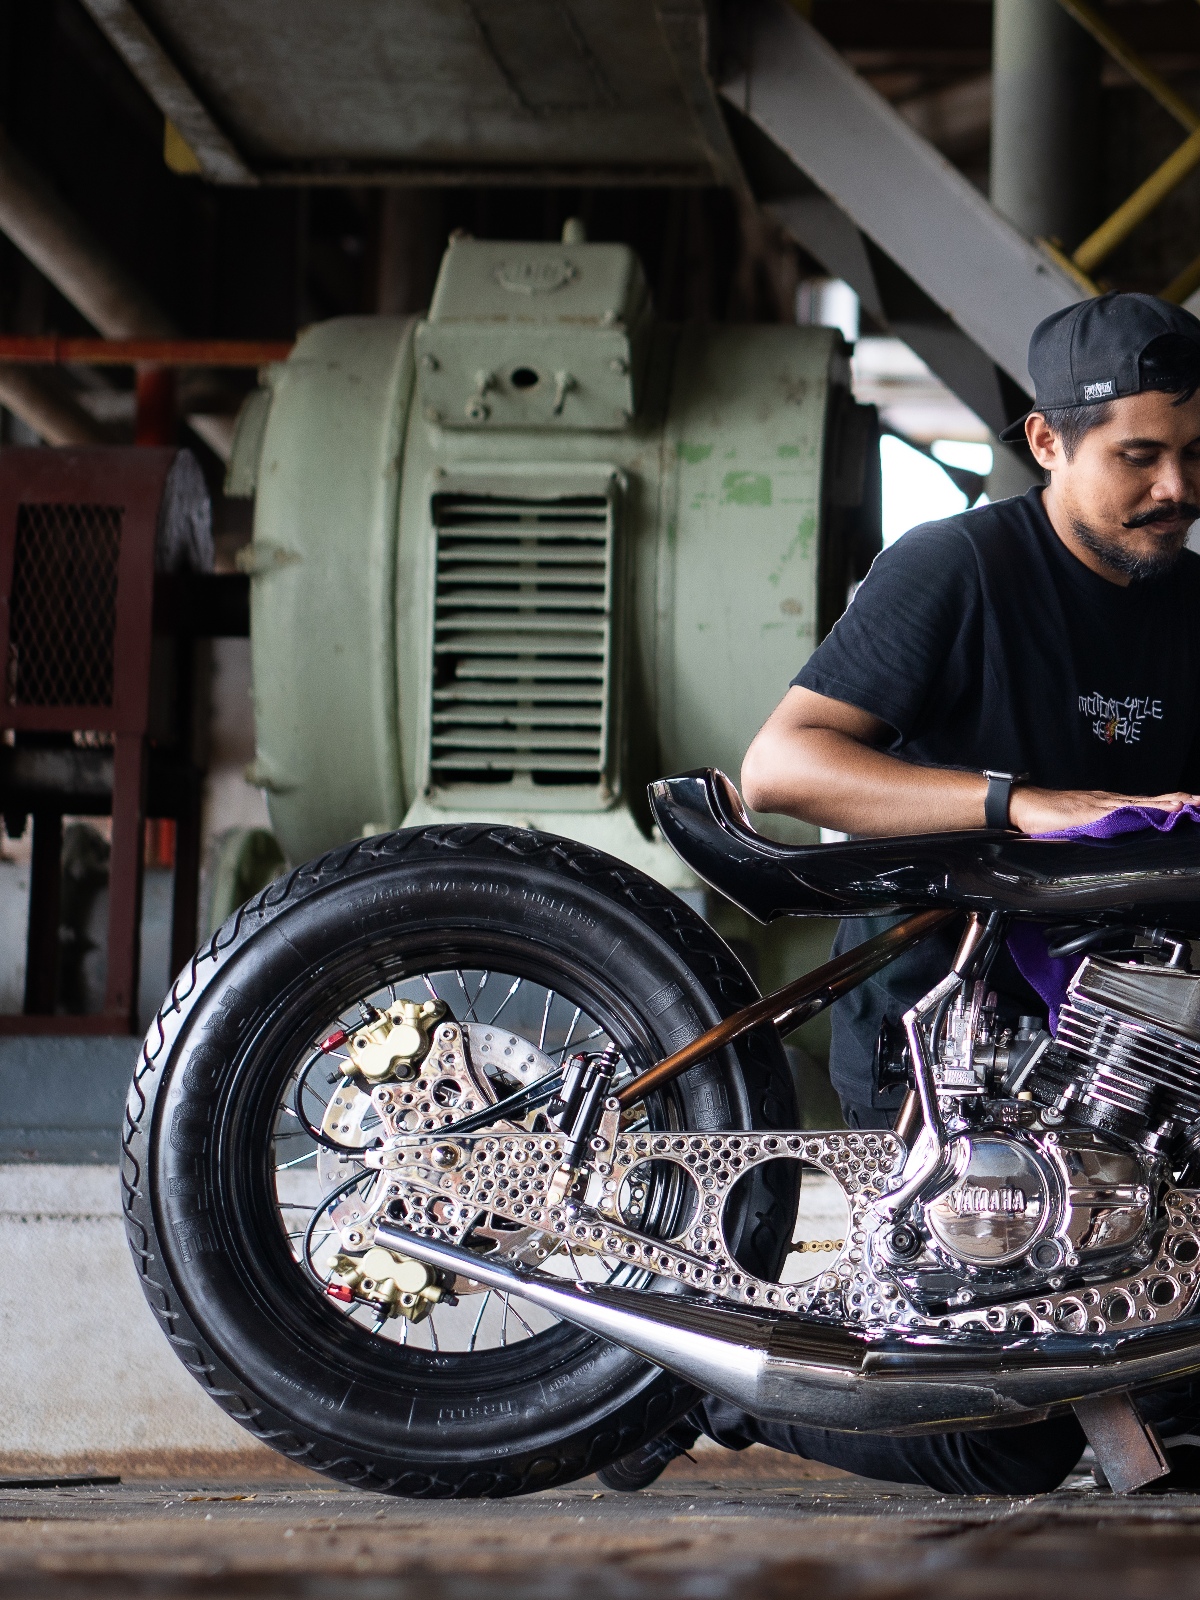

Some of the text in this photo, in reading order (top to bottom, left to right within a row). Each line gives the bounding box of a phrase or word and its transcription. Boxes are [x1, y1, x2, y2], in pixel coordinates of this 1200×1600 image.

[1079, 691, 1163, 721] MOTORCYCLE
[168, 983, 260, 1264] ROUTE
[952, 1188, 1025, 1212] YAMAHA
